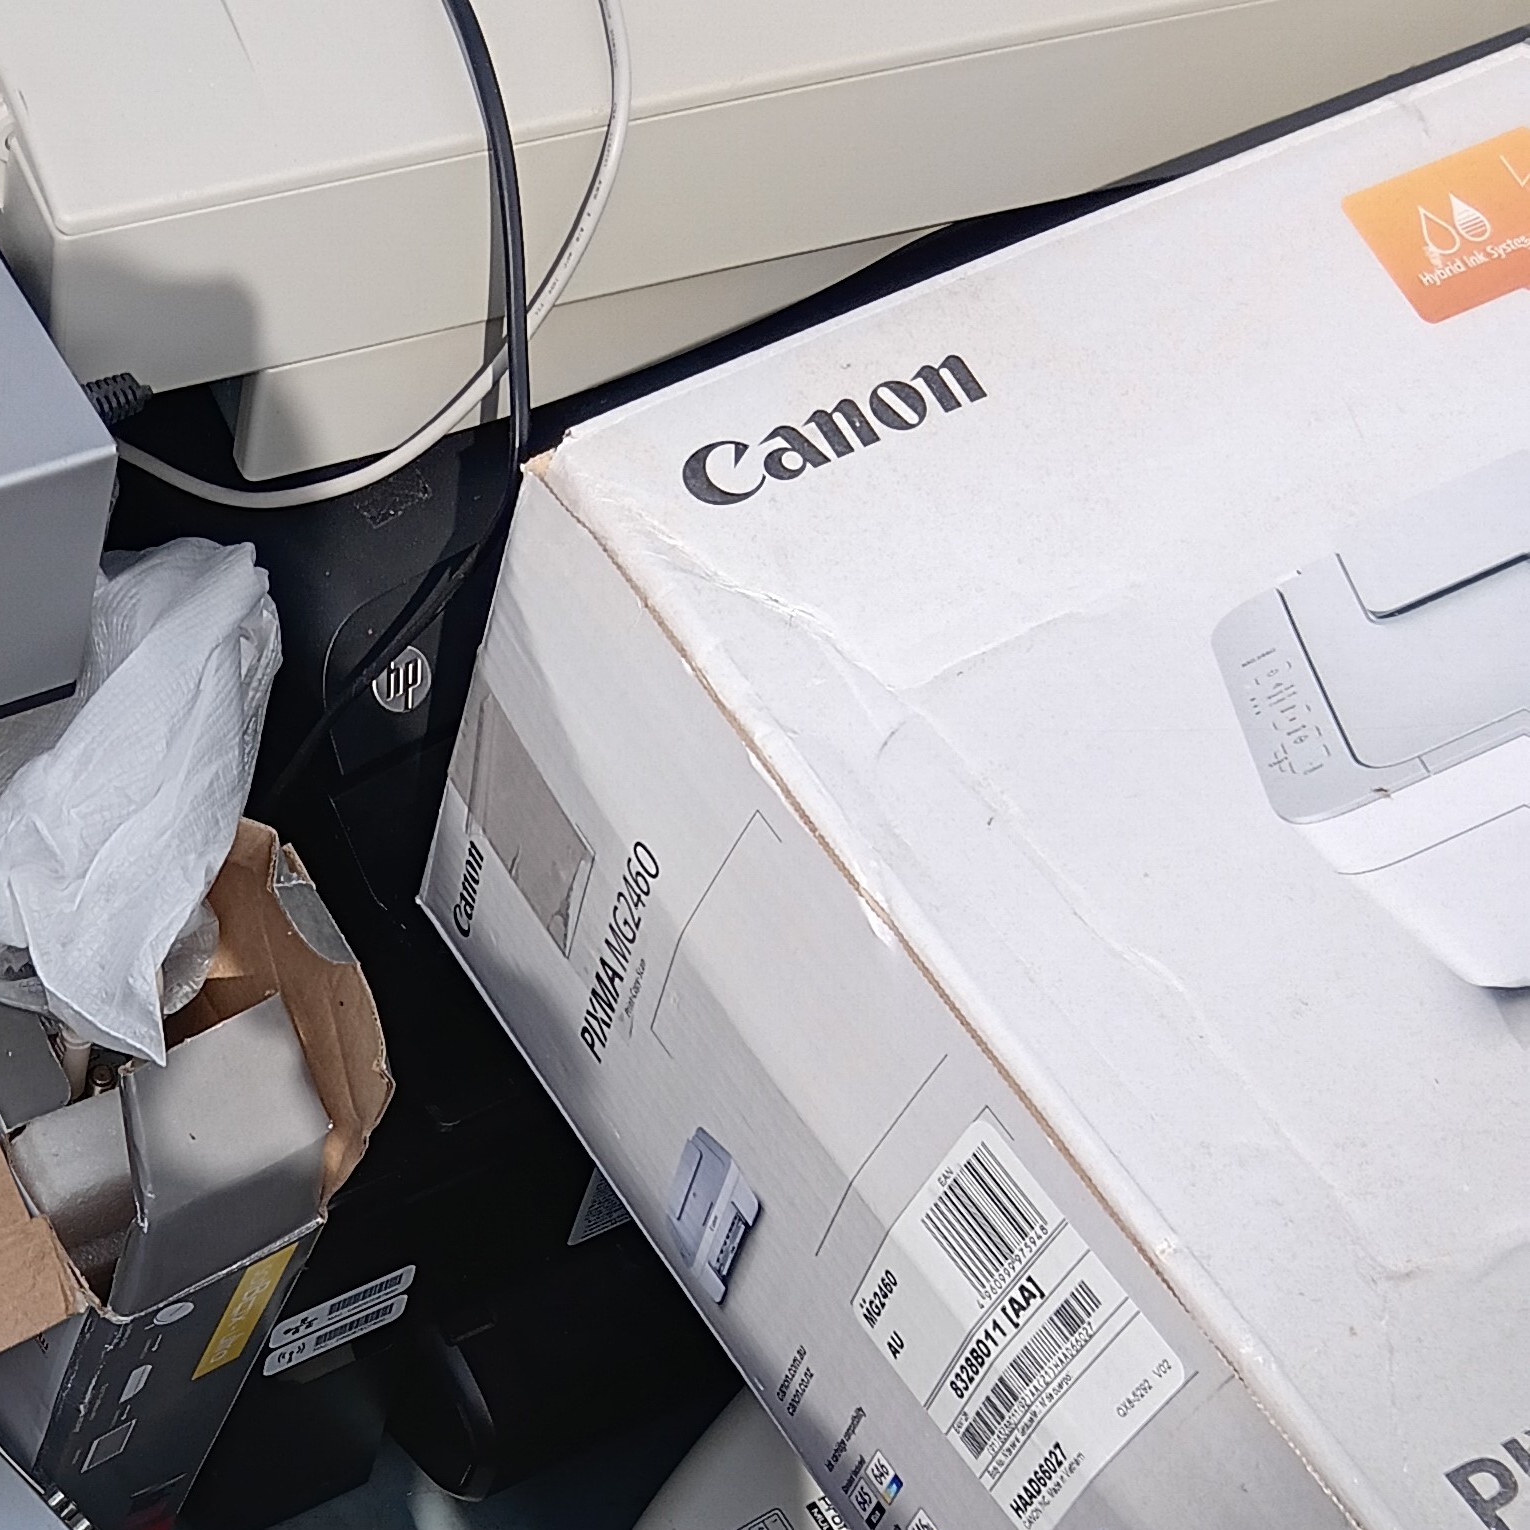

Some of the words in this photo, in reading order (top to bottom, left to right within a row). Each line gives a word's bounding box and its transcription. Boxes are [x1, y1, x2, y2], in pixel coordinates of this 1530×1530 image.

[1419, 257, 1466, 286] Hybrid
[1467, 249, 1490, 269] Ink
[682, 354, 988, 506] Canon
[453, 840, 485, 938] Canon
[580, 956, 625, 1064] PIXMA
[604, 841, 660, 964] MG2460
[937, 1167, 954, 1188] EAN
[862, 1269, 899, 1330] MG2460
[887, 1331, 906, 1360] AU
[949, 1318, 1008, 1400] 8328B011
[1001, 1275, 1047, 1330] [AA]
[776, 1344, 808, 1403] canon.com.au
[786, 1366, 815, 1418] canon.co.nz
[1152, 1358, 1173, 1380] V02
[855, 1486, 873, 1513] 645
[871, 1458, 890, 1486] 646
[1009, 1440, 1070, 1520] HAAD66027
